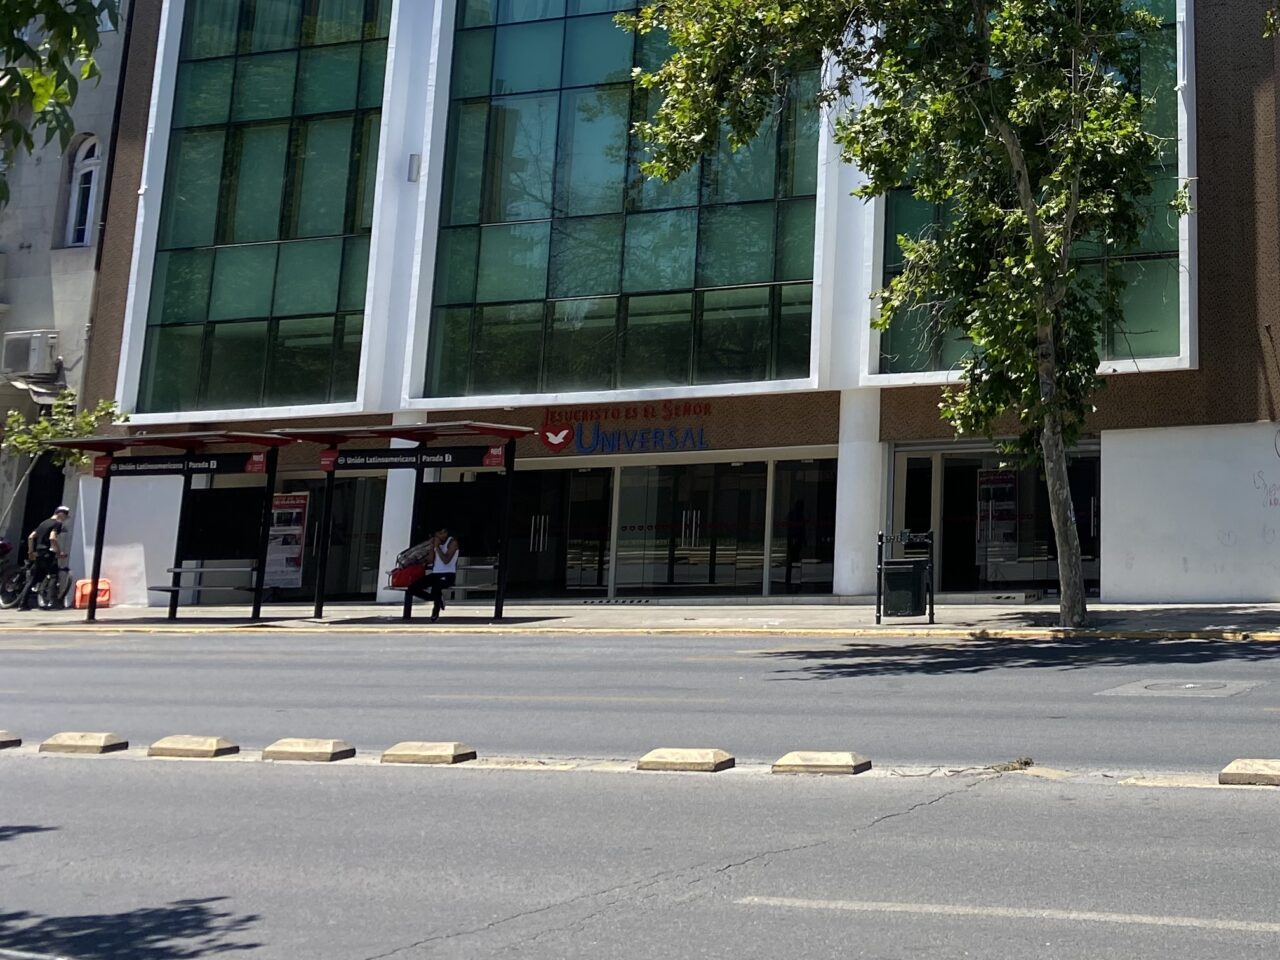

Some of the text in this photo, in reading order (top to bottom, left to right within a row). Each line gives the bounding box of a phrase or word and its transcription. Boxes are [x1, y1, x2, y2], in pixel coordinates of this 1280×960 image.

[575, 422, 709, 453] UNIVERSAL
[422, 454, 443, 462] Parada
[189, 460, 208, 469] Parada
